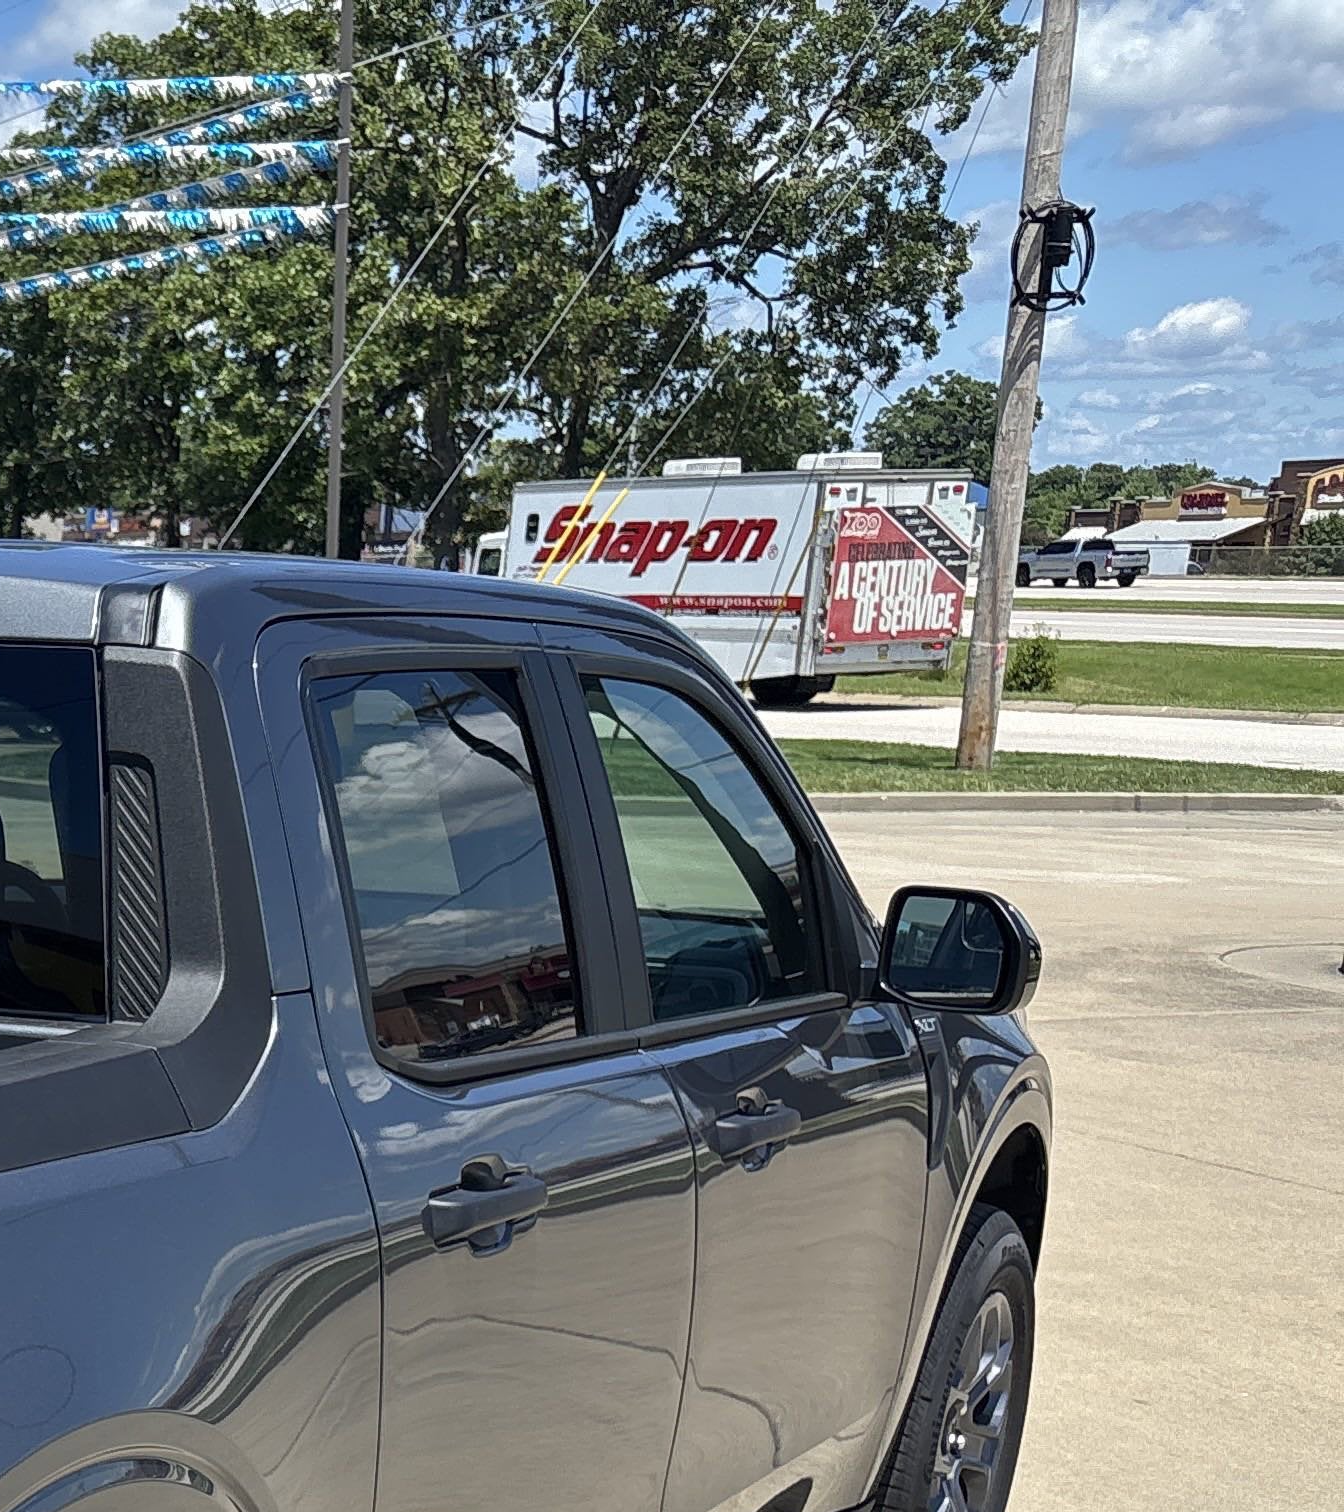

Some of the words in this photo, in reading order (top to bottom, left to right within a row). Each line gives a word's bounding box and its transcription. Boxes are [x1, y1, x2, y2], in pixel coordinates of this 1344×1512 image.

[834, 562, 850, 600] A
[852, 559, 938, 599] CENTURY
[852, 596, 878, 634] OF
